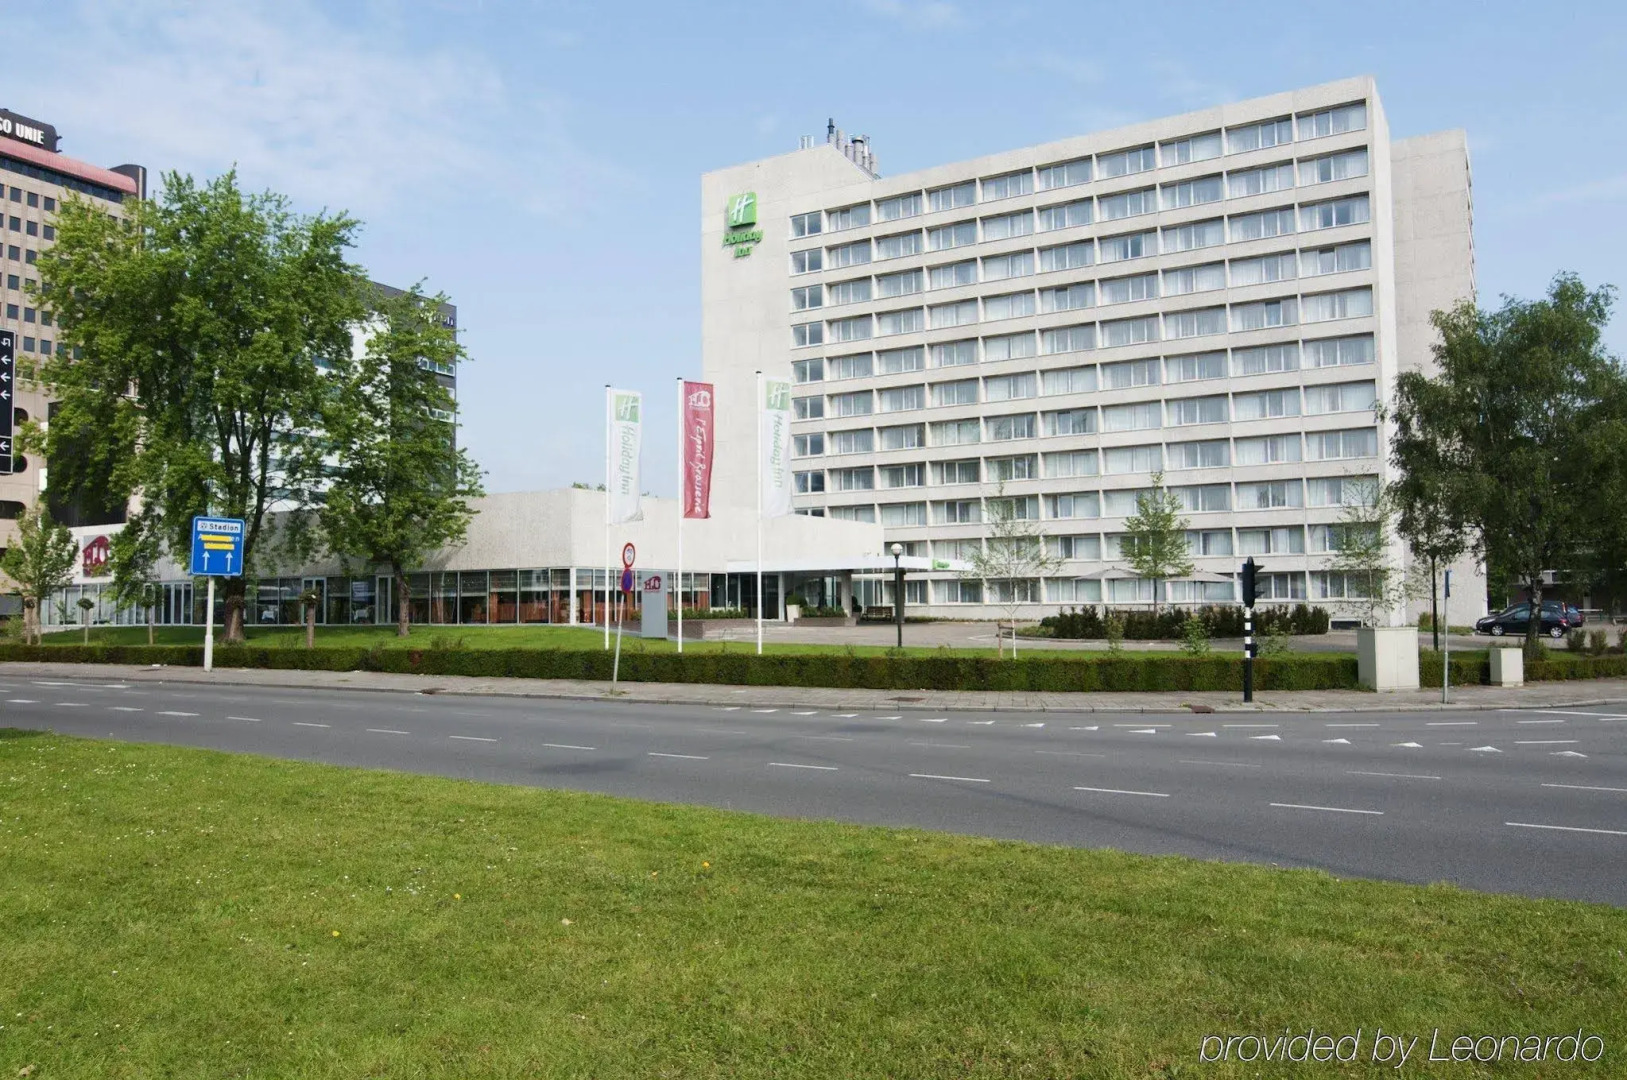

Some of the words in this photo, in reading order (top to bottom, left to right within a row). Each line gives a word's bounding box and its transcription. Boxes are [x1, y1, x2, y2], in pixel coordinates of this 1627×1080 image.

[15, 122, 45, 145] UNIE
[619, 425, 636, 474] Holiday
[769, 413, 784, 466] Holiday
[209, 523, 239, 531] Stadion
